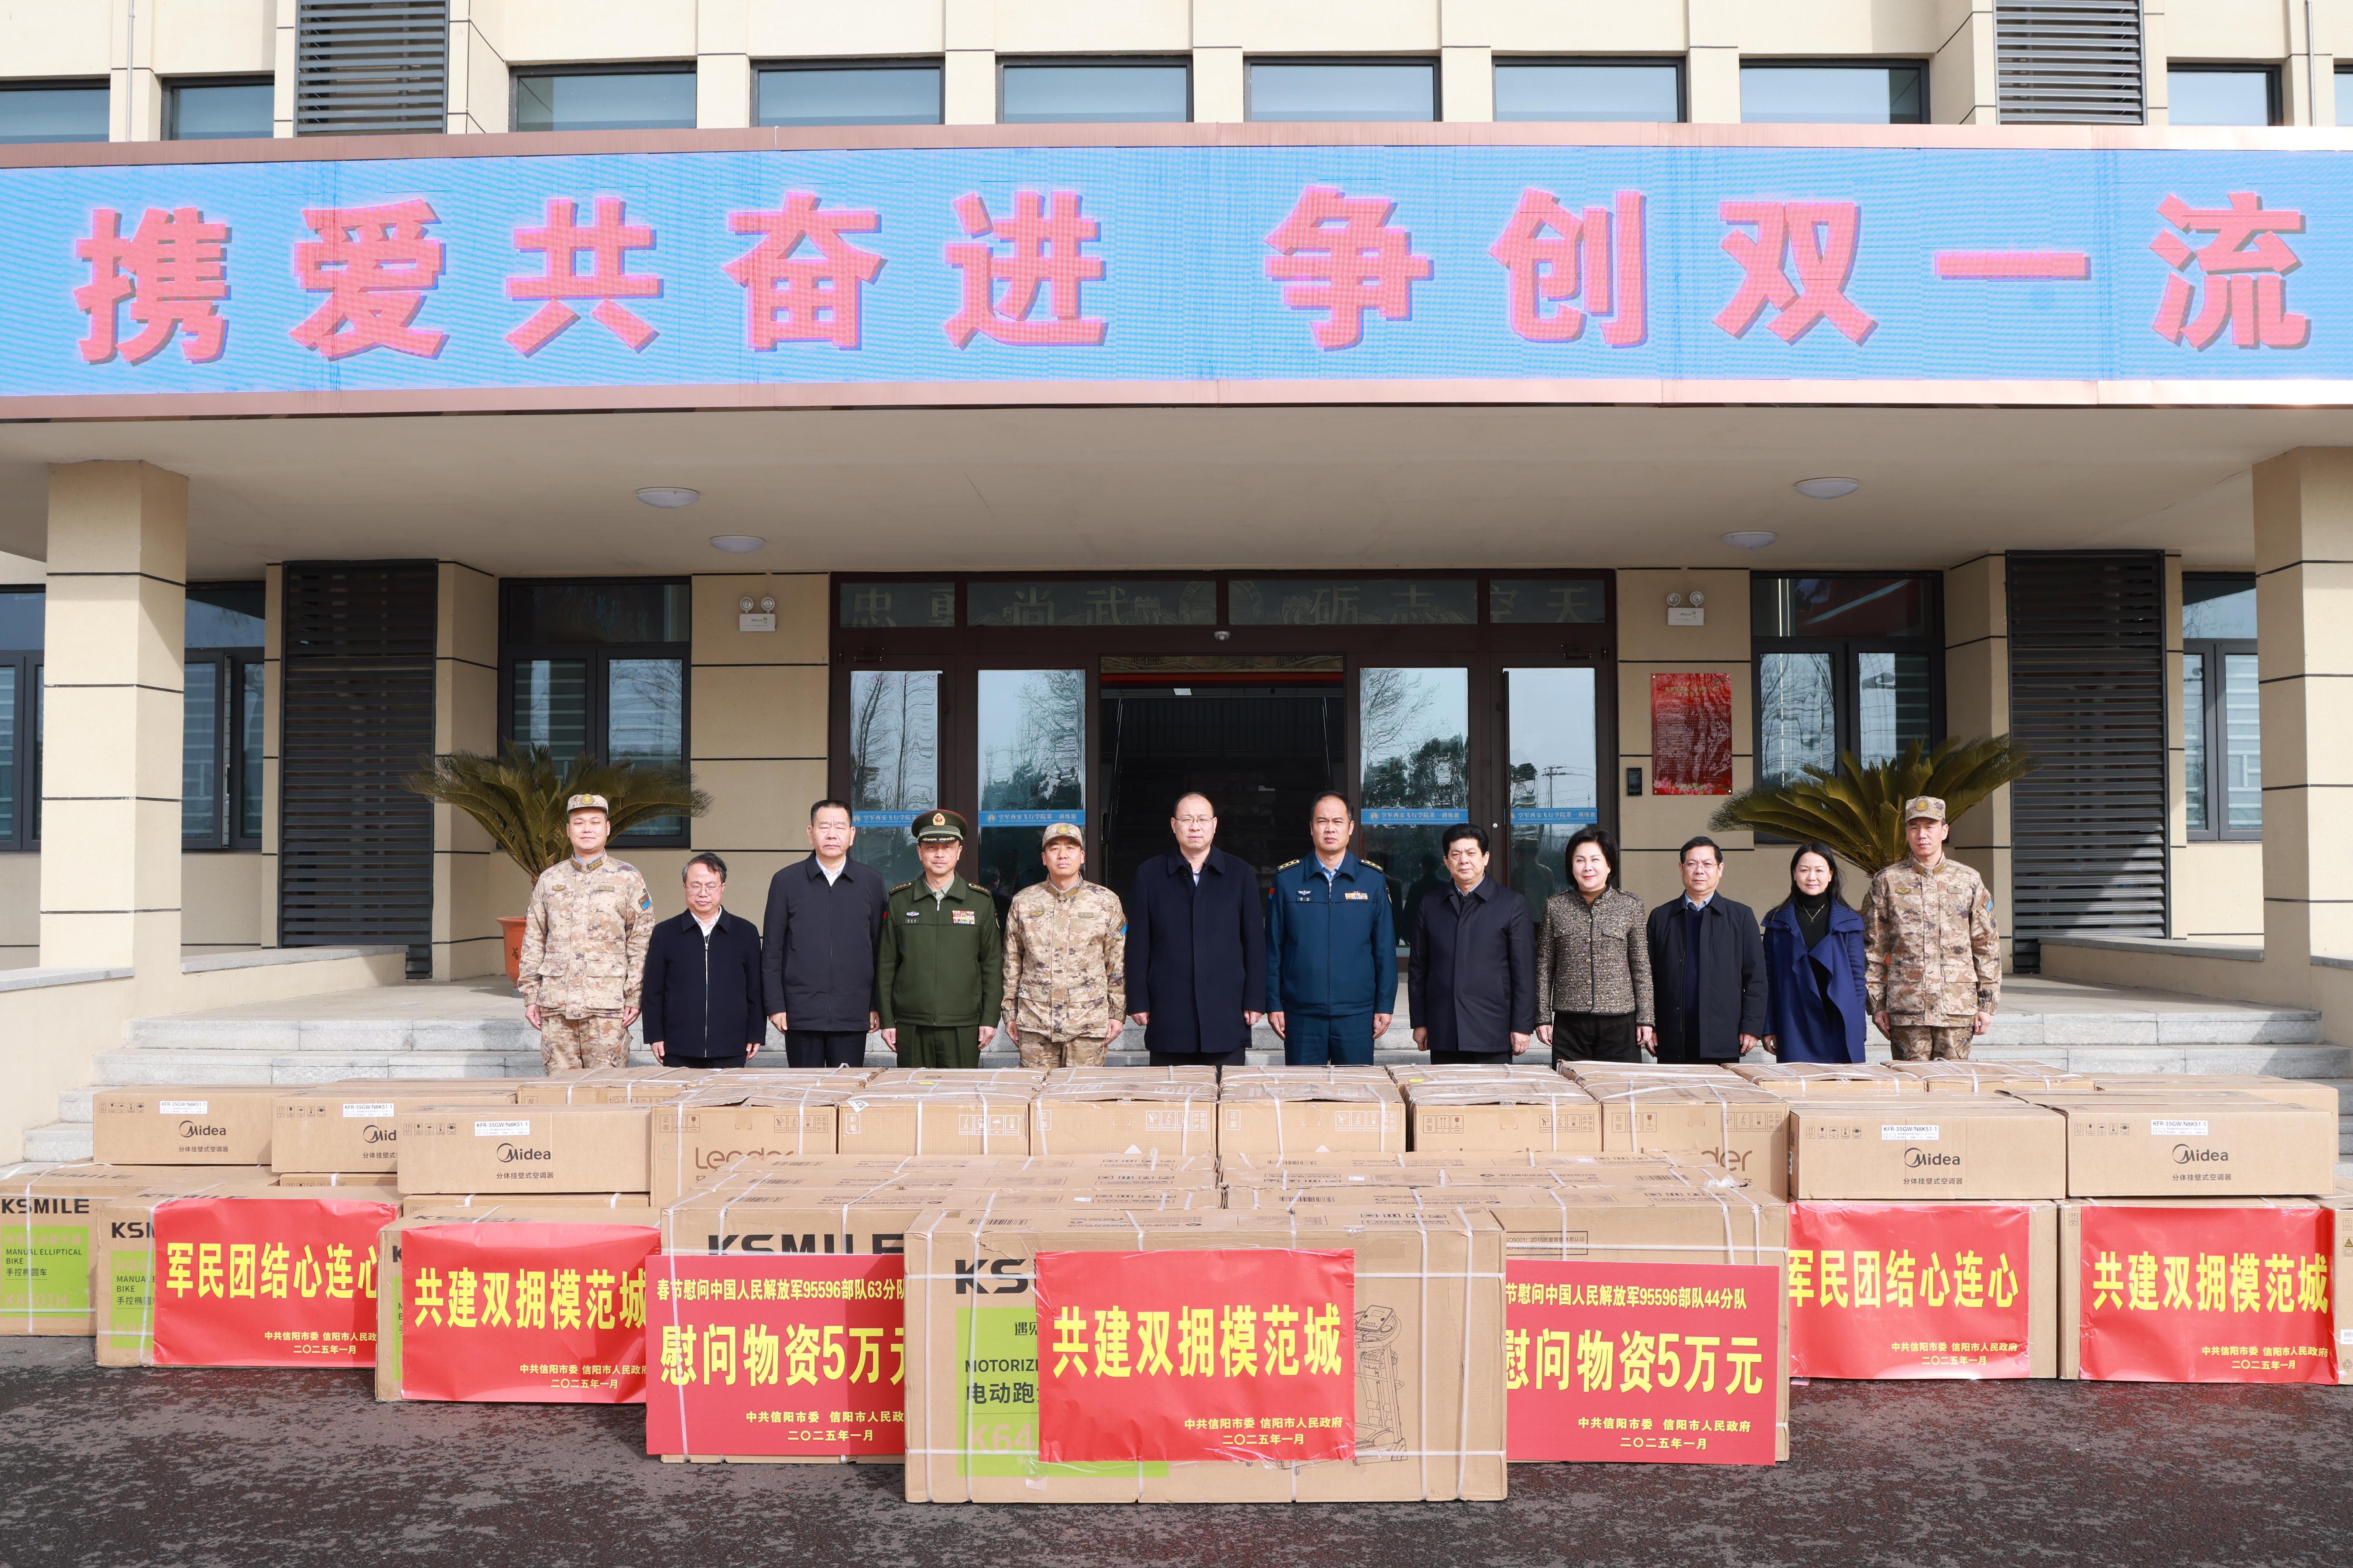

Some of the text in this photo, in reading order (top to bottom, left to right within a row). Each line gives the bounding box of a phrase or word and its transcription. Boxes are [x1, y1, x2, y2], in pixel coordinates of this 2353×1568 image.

[73, 186, 2311, 364] 携爱共奋进 争创双一流
[179, 1120, 226, 1138] Midea
[497, 1143, 551, 1162] Midea
[1904, 1147, 1961, 1168] Midea
[2172, 1144, 2229, 1164] Midea
[2, 1199, 89, 1214] KSMILE
[166, 1242, 377, 1299] 军民团结心连心
[955, 1258, 1035, 1294] KS
[1788, 1249, 2019, 1309] 军民团结心连心
[2093, 1251, 2329, 1314] 共建双拥模范城
[116, 1296, 155, 1305] 手控椭圆
[414, 1267, 646, 1330] 共建双拥模范城
[264, 1331, 319, 1342] 中共信阳市委
[1052, 1302, 1342, 1379] 共建双拥模范城
[1891, 1342, 2018, 1352] 中共信阳市委 信阳市人民政府
[2202, 1346, 2329, 1358] 中共信阳市委 信阳市人民政府
[519, 1364, 578, 1375] 中共信阳市委
[965, 1359, 1038, 1373] MOTORIZ
[1506, 1327, 1763, 1395] 慰问物资5万元
[966, 1382, 1038, 1404] 电动跑
[746, 1411, 820, 1424] 中共信阳市委
[1184, 1416, 1343, 1430] 中共信阳市委 信阳市人民政府
[1578, 1417, 1751, 1433] 中共信阳市委 信阳市人民政府
